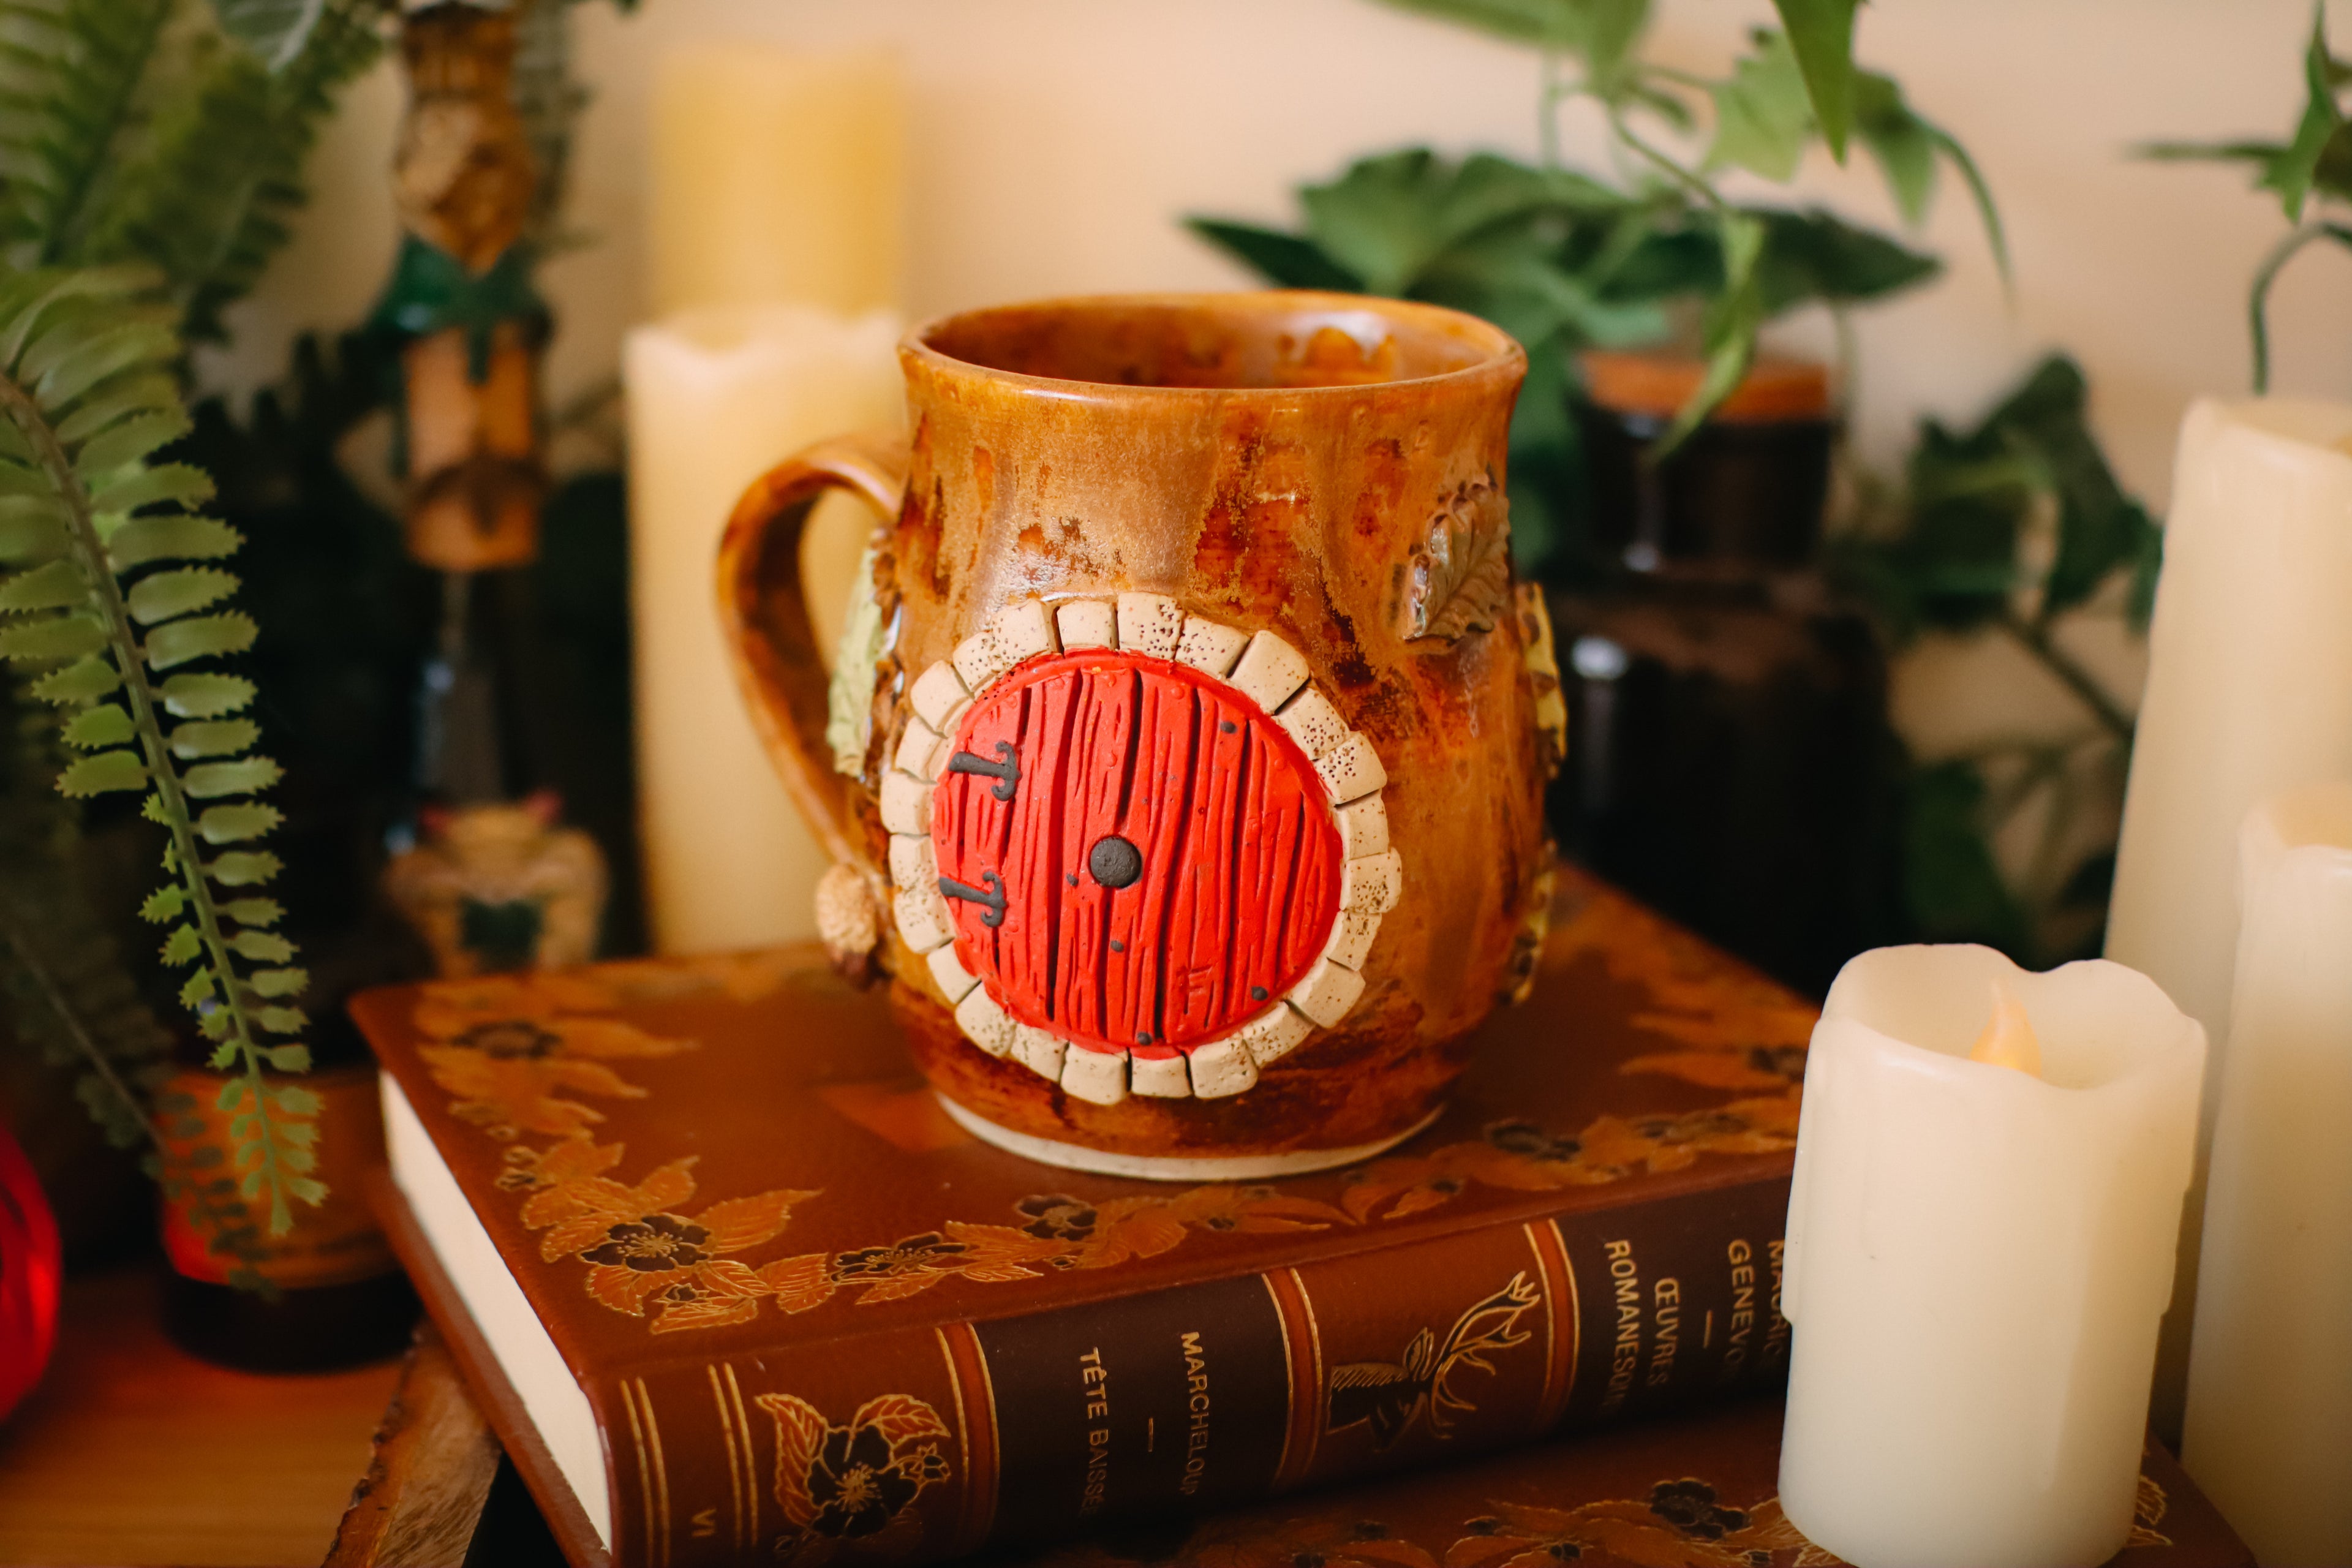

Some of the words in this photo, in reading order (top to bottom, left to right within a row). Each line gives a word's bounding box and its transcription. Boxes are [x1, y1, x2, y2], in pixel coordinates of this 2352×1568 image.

[1080, 1347, 1107, 1419] TÊTE
[1181, 1332, 1210, 1495] MARCHELOUP
[691, 1508, 717, 1538] VI
